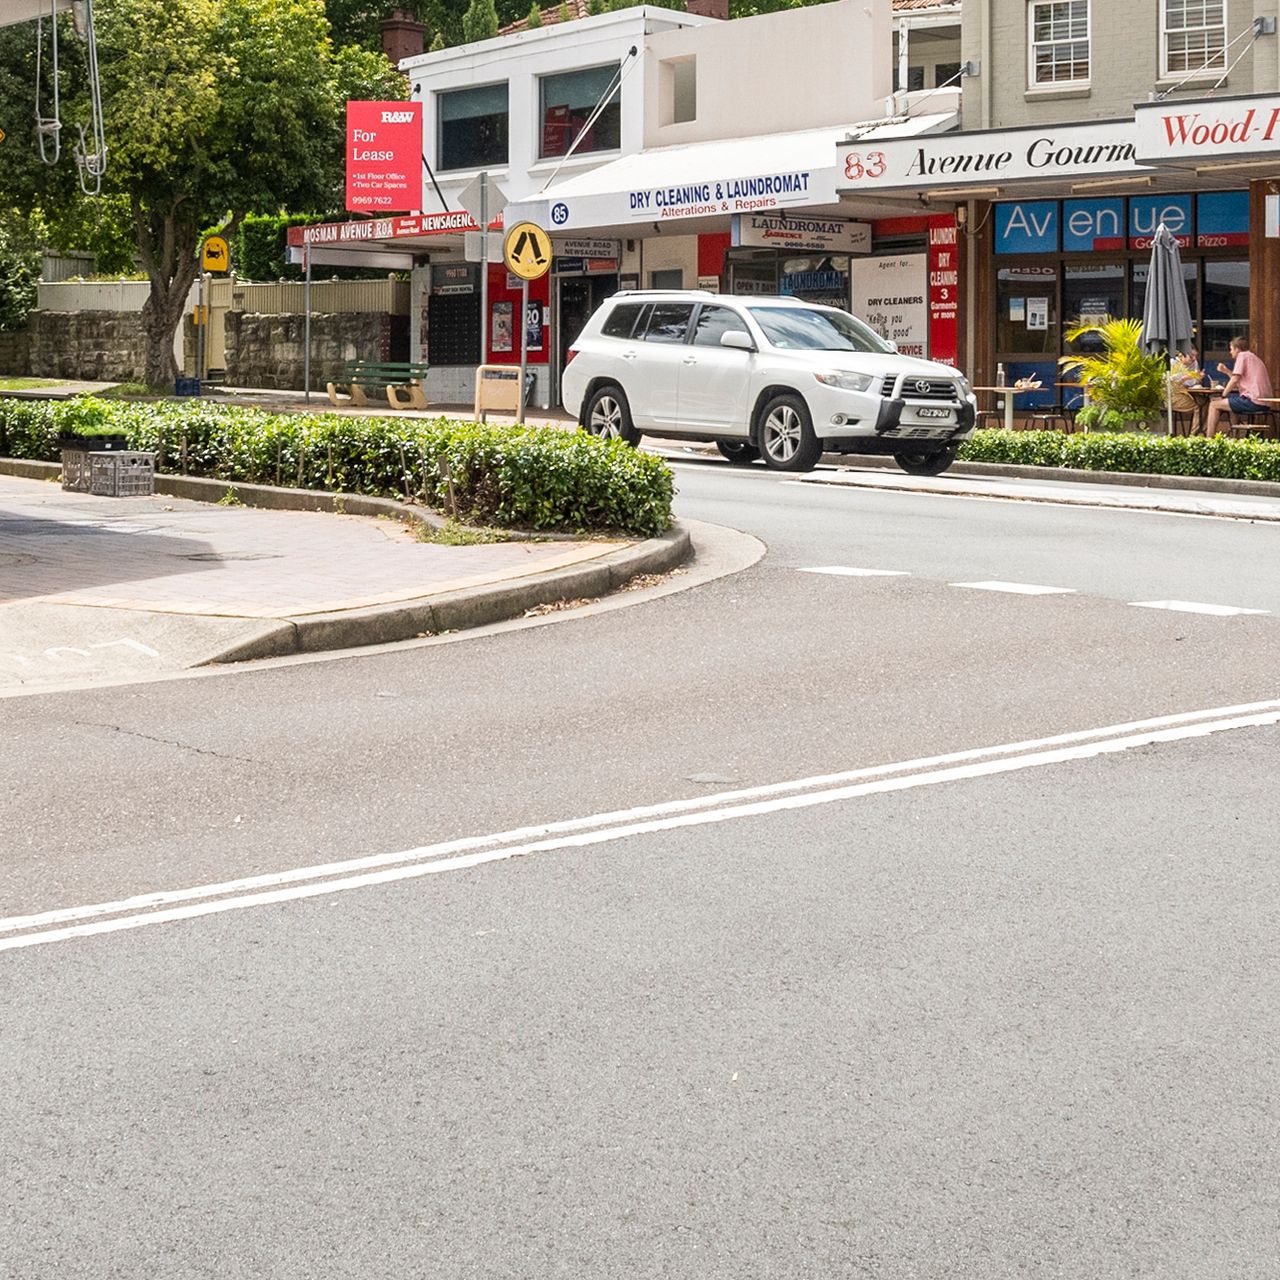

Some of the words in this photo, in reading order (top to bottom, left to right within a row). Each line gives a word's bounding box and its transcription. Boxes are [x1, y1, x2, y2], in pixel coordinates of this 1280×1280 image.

[381, 111, 415, 123] R&W
[353, 129, 377, 142] For
[353, 148, 394, 161] Lease
[843, 151, 888, 180] 83
[905, 148, 1013, 177] Avenue
[367, 172, 385, 180] Floor
[386, 172, 406, 180] Office
[371, 181, 383, 189] Car
[384, 181, 407, 190] Spaces
[630, 191, 651, 209] DRY
[655, 184, 711, 208] CLEANING
[715, 183, 723, 200] &
[726, 173, 809, 199] LAUNDROMAT
[352, 196, 373, 205] 9969
[373, 197, 392, 205] 7622
[661, 203, 717, 218] Alterations
[721, 201, 729, 211] &
[735, 196, 776, 211] Repairs
[553, 206, 567, 223] 85
[422, 213, 477, 231] NEWSAGENC
[751, 218, 844, 234] LAUNDROMAT
[303, 226, 337, 243] MOSMAN
[340, 223, 373, 240] AVENUE
[929, 227, 957, 245] LAUNDRY
[564, 240, 590, 249] AVENUE
[593, 241, 612, 249] ROAD
[1135, 236, 1190, 249] Goet
[1197, 235, 1227, 248] Pizza
[564, 248, 612, 257] NEWSAGENCY
[878, 261, 896, 270] Agent
[938, 252, 951, 268] DRY
[930, 271, 958, 287] CLEANING
[736, 281, 753, 291] OPEN
[940, 288, 949, 300] 3
[867, 298, 882, 307] DRY
[883, 295, 924, 306] CLEANERS
[930, 301, 958, 310] Garments
[891, 315, 903, 326] you
[940, 311, 956, 319] more
[898, 345, 923, 356] ERVICE
